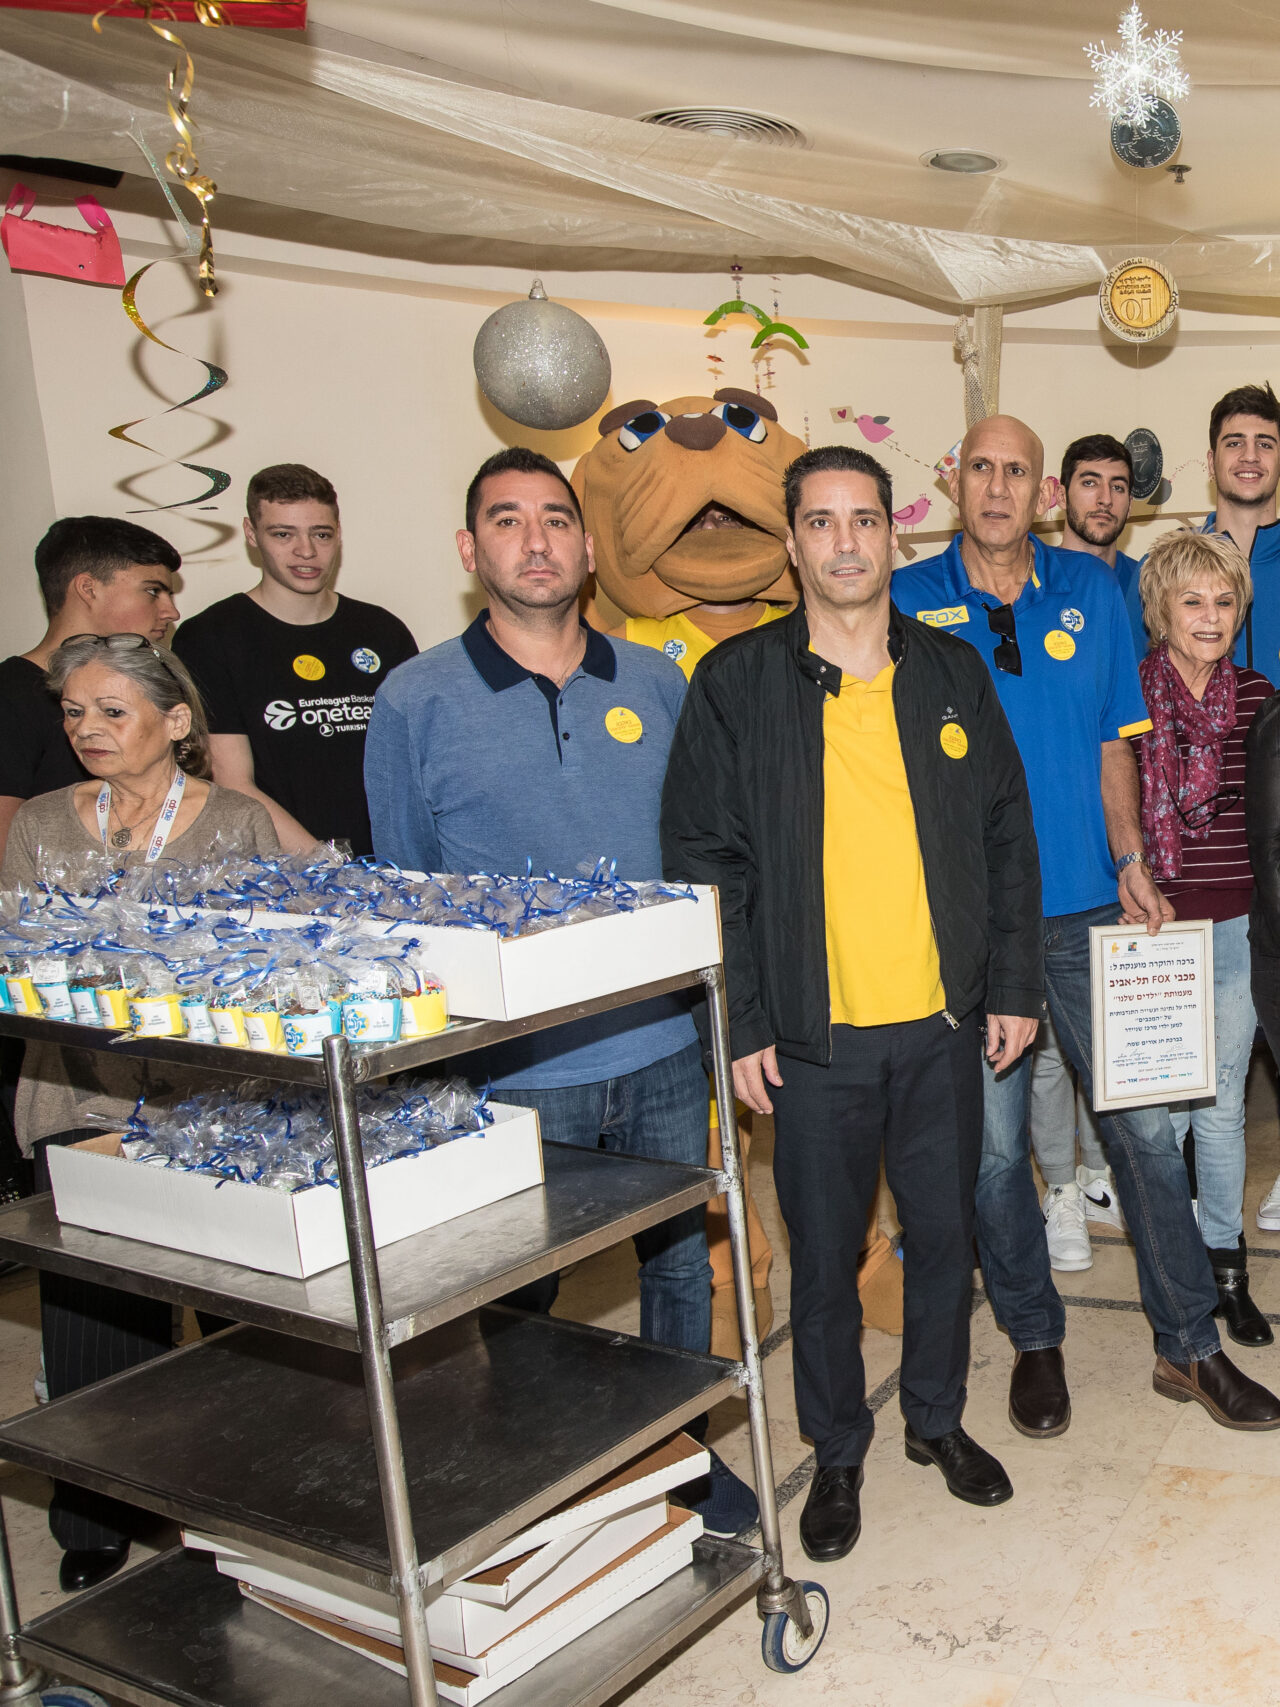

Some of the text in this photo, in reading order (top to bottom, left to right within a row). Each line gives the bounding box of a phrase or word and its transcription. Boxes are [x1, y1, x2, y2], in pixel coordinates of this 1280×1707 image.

[923, 609, 965, 623] FOX
[299, 695, 350, 708] Euroleague
[335, 723, 367, 732] TURKISH
[1119, 961, 1147, 970] מוענקת
[1148, 959, 1175, 968] והוקרה
[1176, 958, 1195, 966] ברכה
[1109, 972, 1196, 987] מכבי FOX תל-אביב
[1164, 989, 1193, 998] מעמותת
